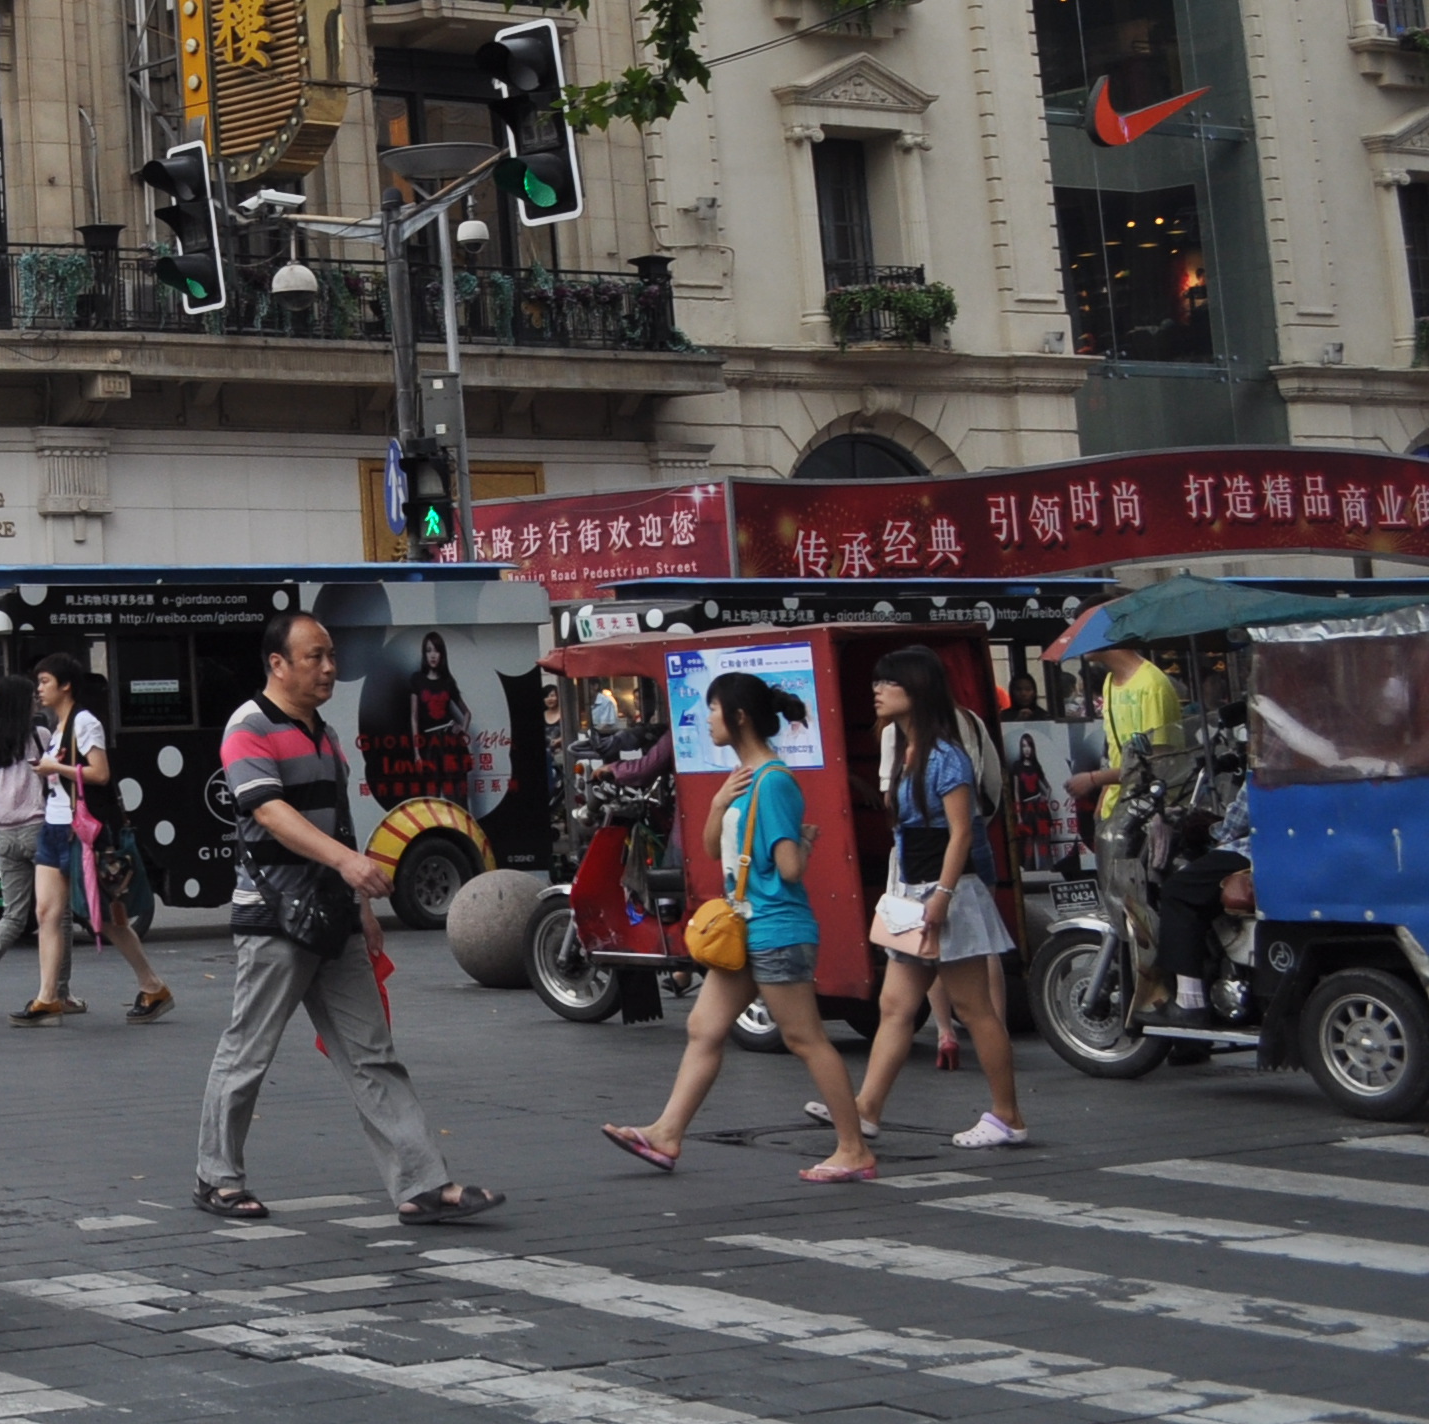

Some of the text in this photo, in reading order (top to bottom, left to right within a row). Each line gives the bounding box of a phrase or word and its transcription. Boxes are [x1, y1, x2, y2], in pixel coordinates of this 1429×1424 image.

[987, 480, 1142, 543] 引领时尚
[793, 518, 963, 577] 传承经典
[550, 568, 577, 582] Road
[582, 565, 650, 581] Pedestrian
[655, 560, 699, 575] Street
[162, 594, 248, 607] e-giordano.com
[119, 612, 265, 626] http://weibo.com/giordano
[355, 733, 471, 752] GIORDANO
